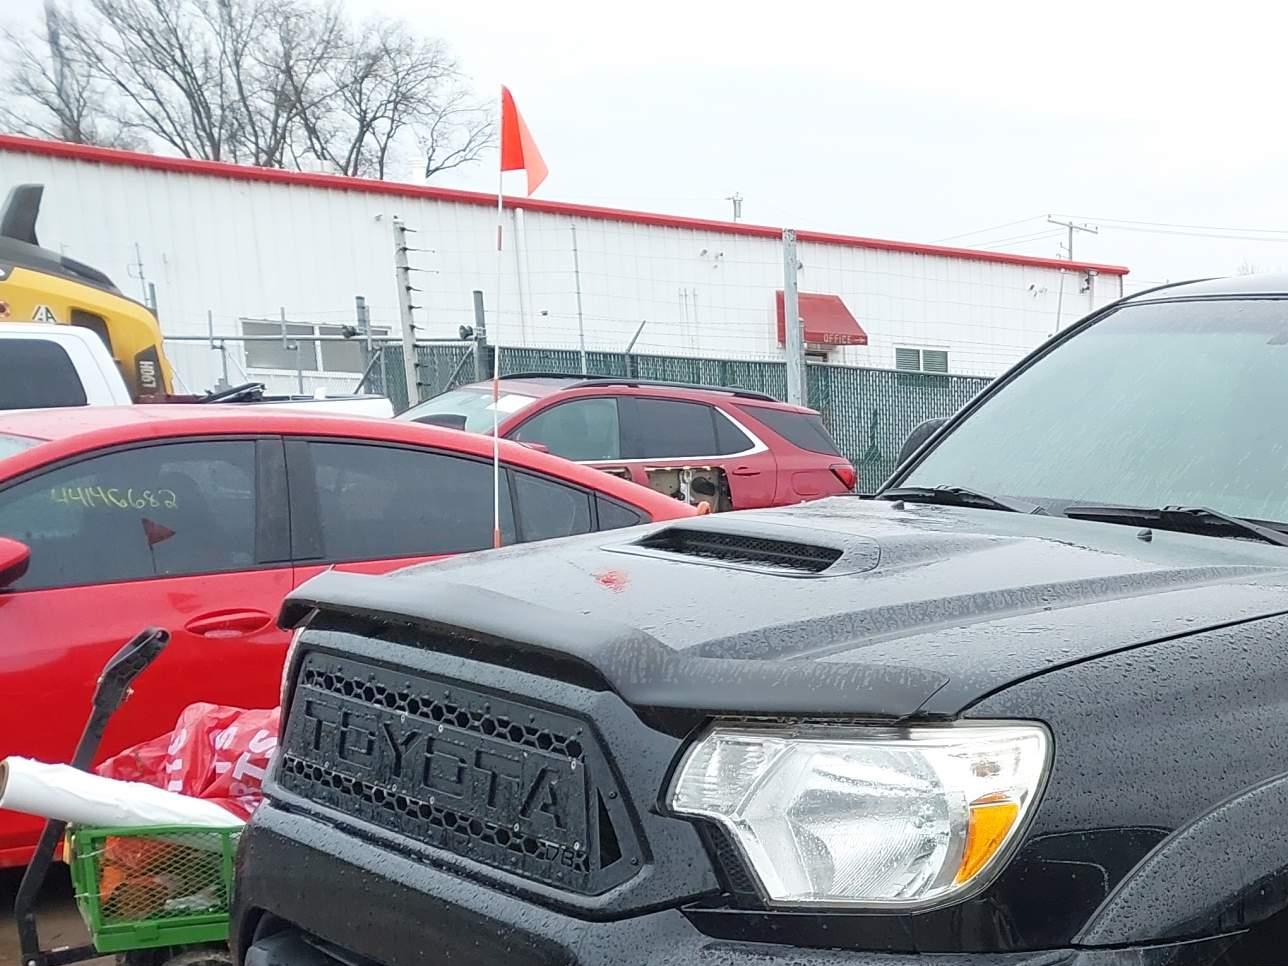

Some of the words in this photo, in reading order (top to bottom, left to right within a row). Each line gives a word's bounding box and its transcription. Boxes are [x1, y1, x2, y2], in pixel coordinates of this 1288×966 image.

[823, 333, 851, 344] OFFICE
[51, 486, 177, 509] 44146682
[303, 699, 568, 832] TOYOTA
